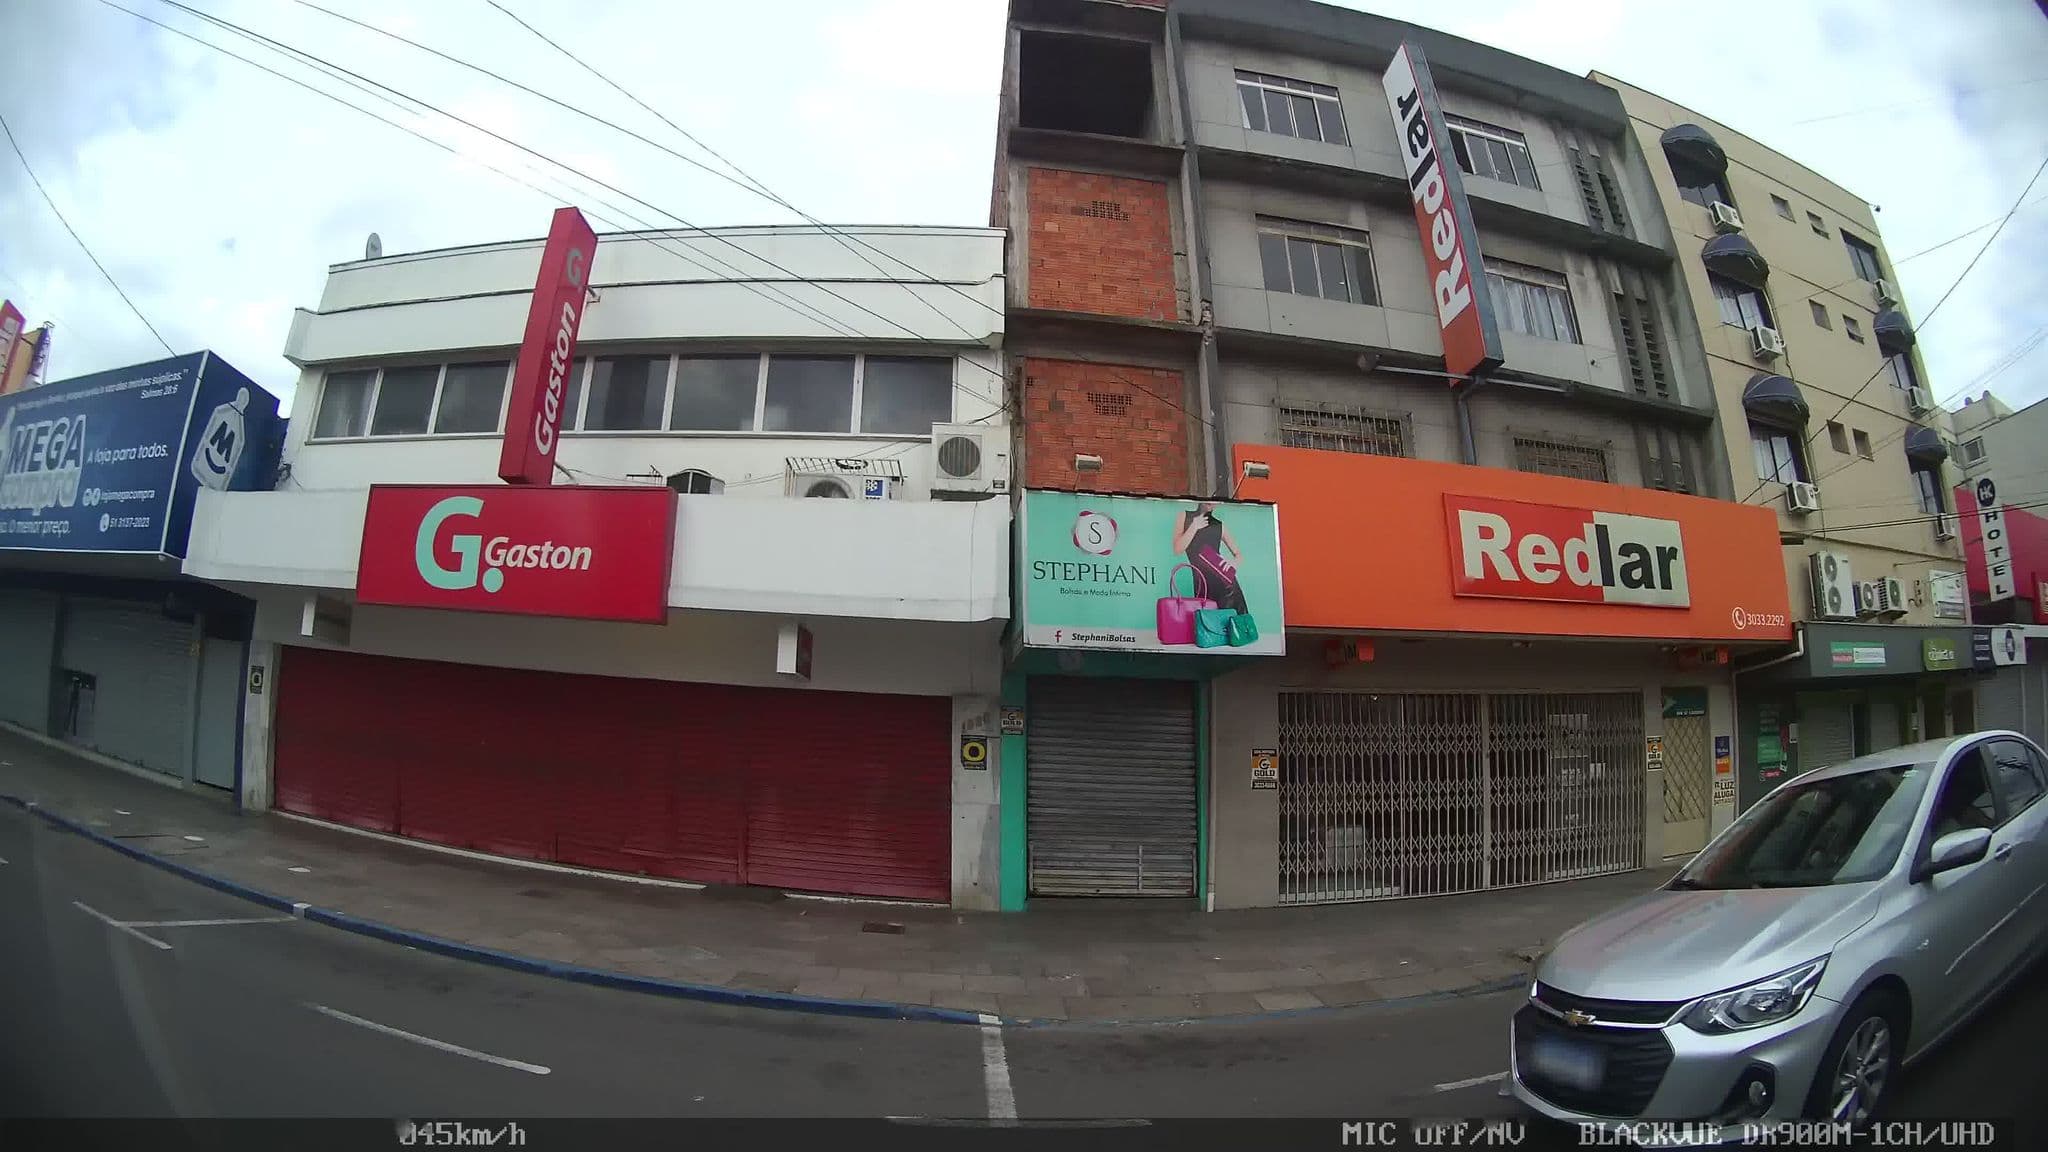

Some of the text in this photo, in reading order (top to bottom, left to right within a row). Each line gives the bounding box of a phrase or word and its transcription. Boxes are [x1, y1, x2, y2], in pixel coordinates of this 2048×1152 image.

[1396, 88, 1472, 330] Redlar
[535, 300, 577, 456] Gaston
[7, 415, 86, 474] MEGA
[112, 448, 137, 464] para
[137, 442, 169, 458] todos.
[1087, 521, 1103, 545] S
[1458, 508, 1678, 592] Redlar
[484, 535, 593, 572] Gaston
[1983, 510, 2008, 596] HOTEL
[1032, 560, 1158, 585] STEPHANI
[1089, 587, 1109, 596] Moda
[1071, 632, 1137, 644] StephaniBolsas
